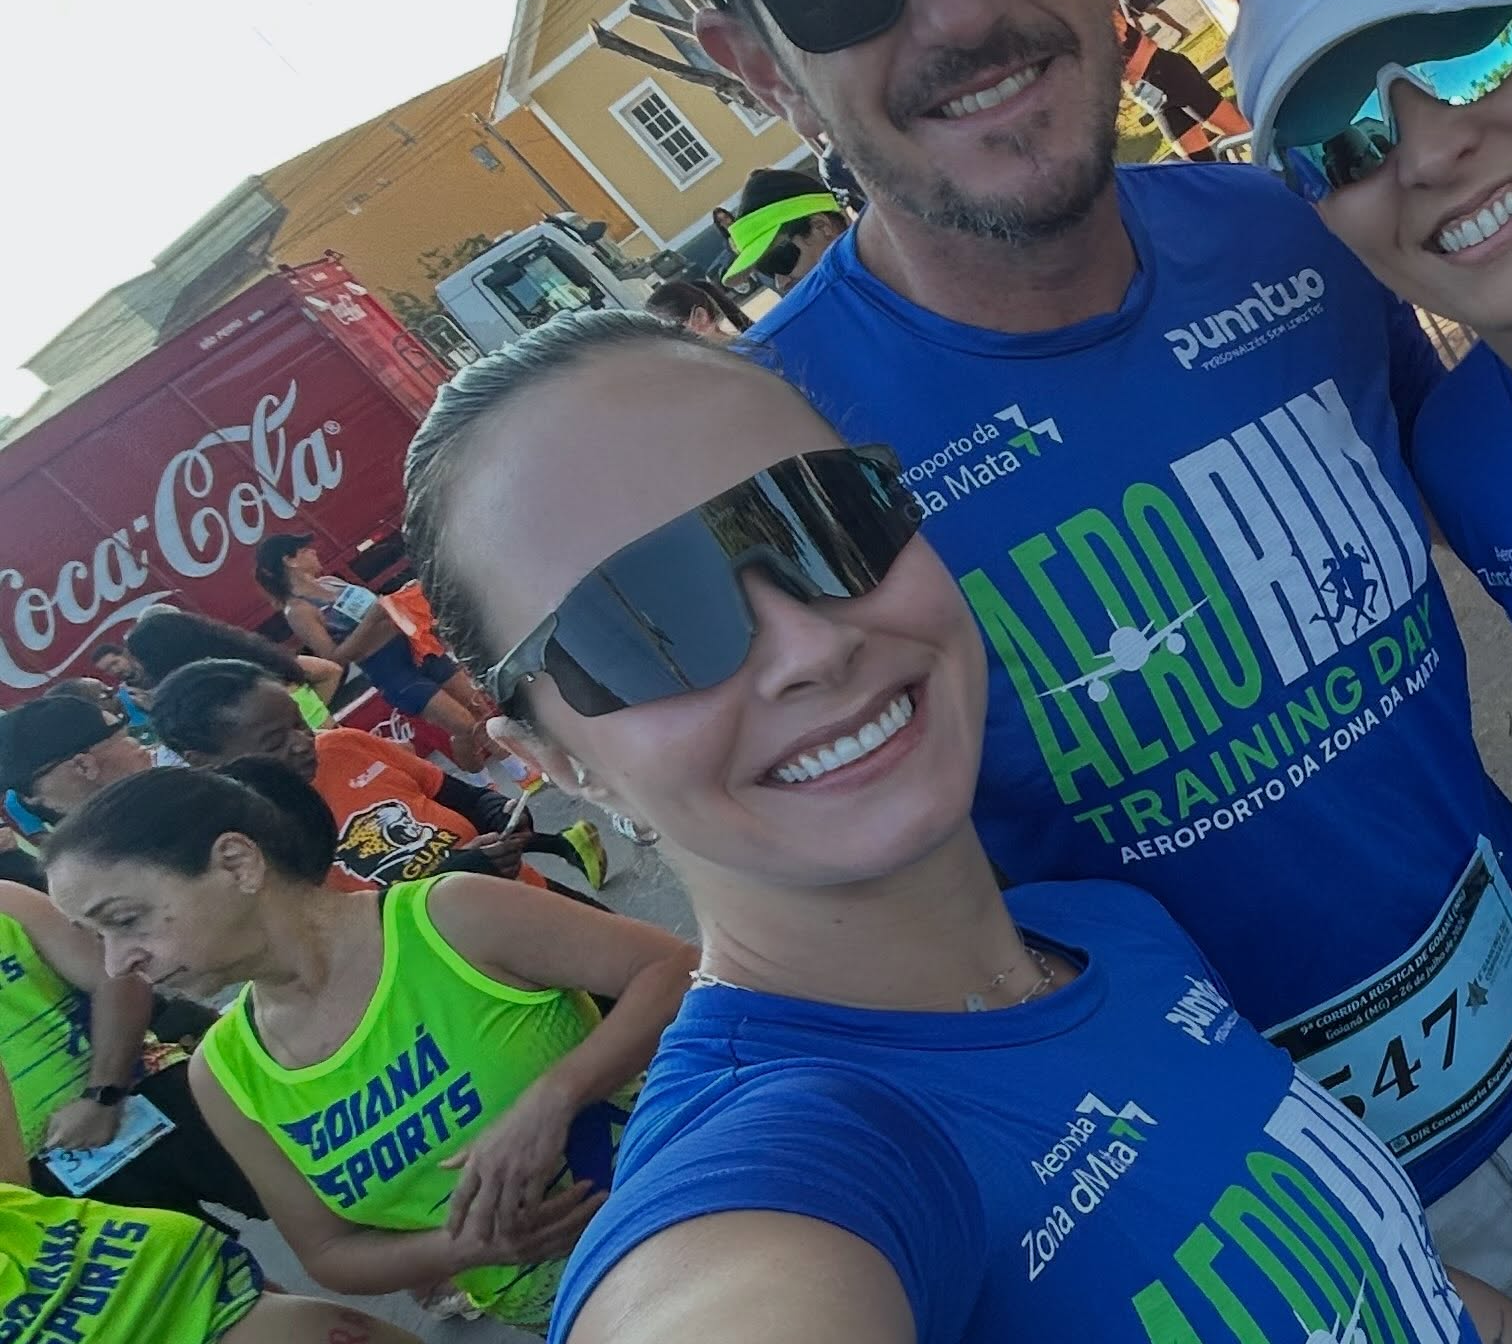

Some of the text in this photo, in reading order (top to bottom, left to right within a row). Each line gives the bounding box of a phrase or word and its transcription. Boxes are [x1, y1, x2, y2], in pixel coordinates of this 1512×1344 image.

[1164, 268, 1325, 369] punntuo
[943, 450, 1021, 500] Mata
[973, 423, 999, 444] da
[1073, 593, 1434, 843] TRAINING DAY
[1120, 647, 1440, 864] AEROPORTO DA ZONA DA MATA
[1316, 997, 1368, 1029] CORRIDA
[1415, 950, 1429, 969] DE
[278, 1023, 449, 1161] GOIANÁ
[307, 1071, 482, 1209] SPORTS
[1021, 1205, 1075, 1281] Zona
